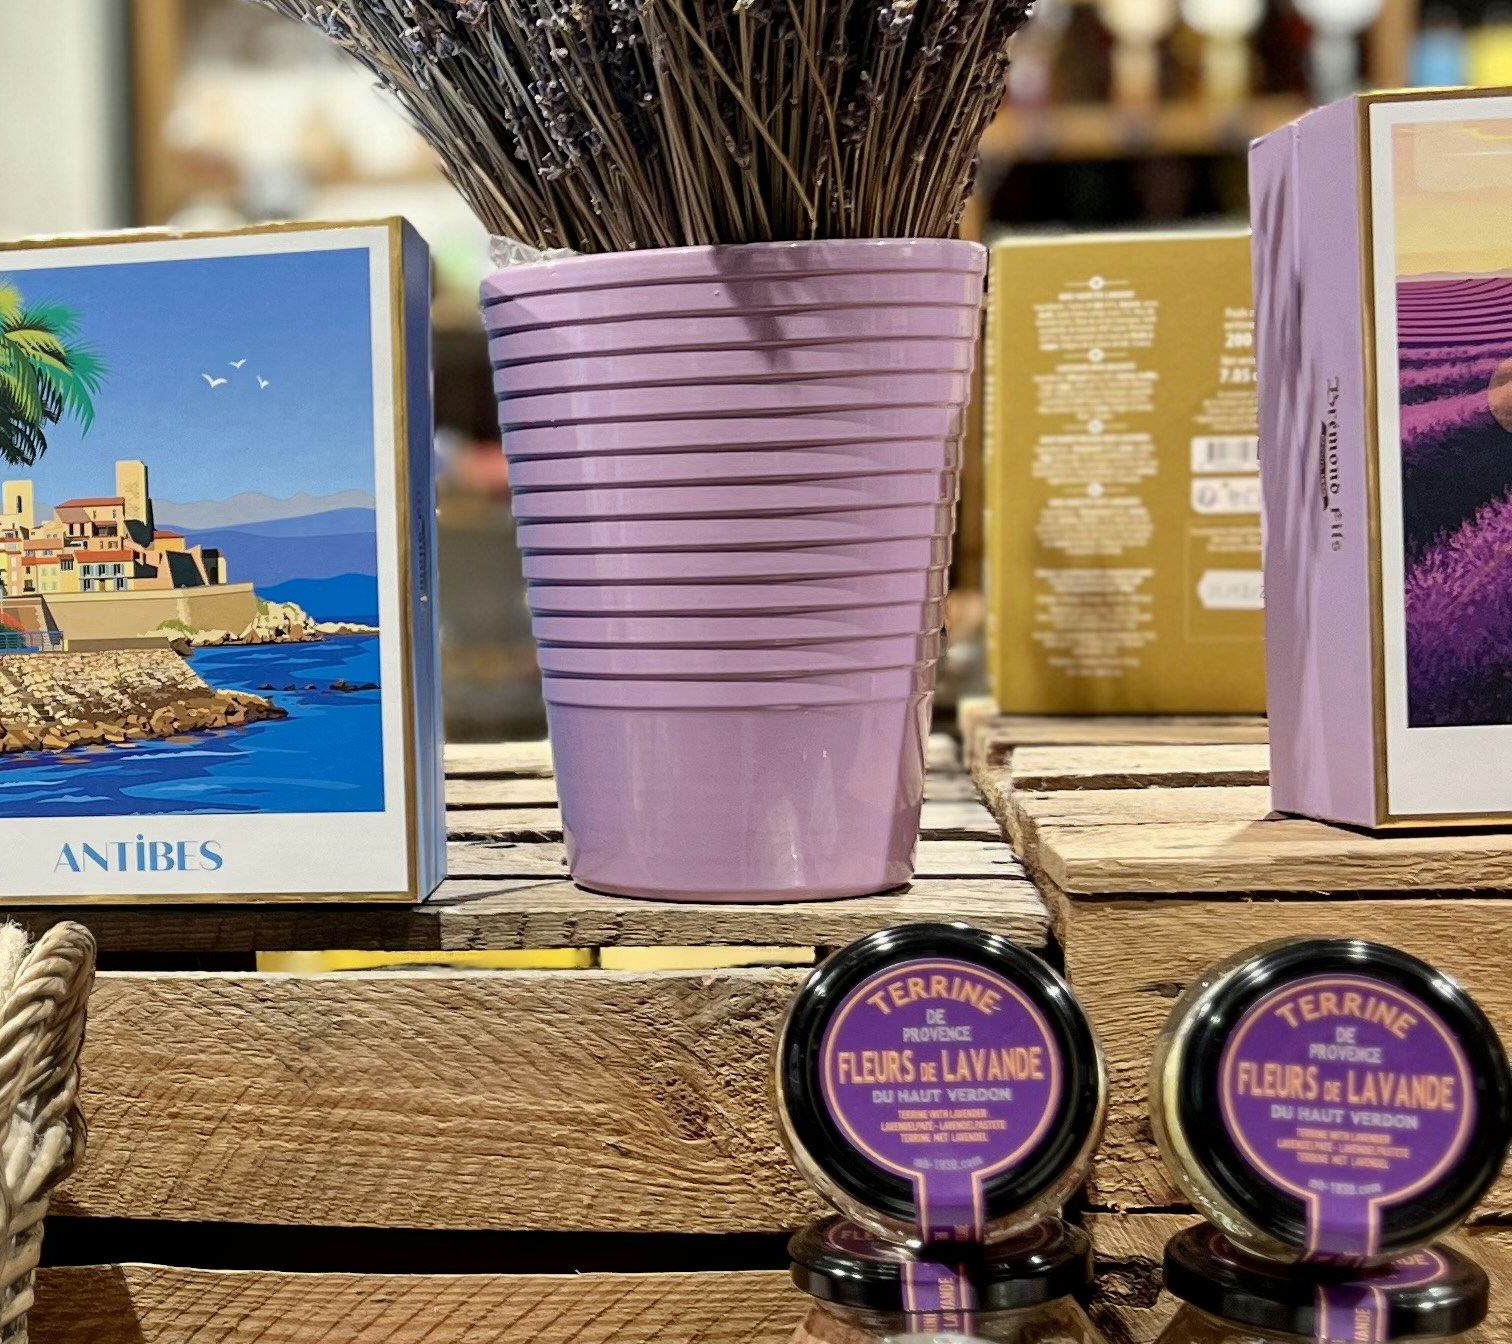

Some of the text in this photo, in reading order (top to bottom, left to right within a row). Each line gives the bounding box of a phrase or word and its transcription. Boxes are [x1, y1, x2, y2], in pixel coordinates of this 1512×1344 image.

[865, 975, 1004, 1016] TERRINE
[926, 1008, 946, 1025] DE
[1274, 991, 1419, 1041] TERRINE
[902, 1025, 973, 1043] PROVENCE
[1335, 1026, 1357, 1044] DE
[838, 1046, 1045, 1085] FLEURS DE LAVANDE
[1309, 1044, 1382, 1065] PROVENCE
[872, 1087, 1014, 1103] DU HAUT VERDON
[1238, 1061, 1456, 1112] FLEURS DE LAVANDE
[1271, 1104, 1420, 1130] DU HAUT VERDON
